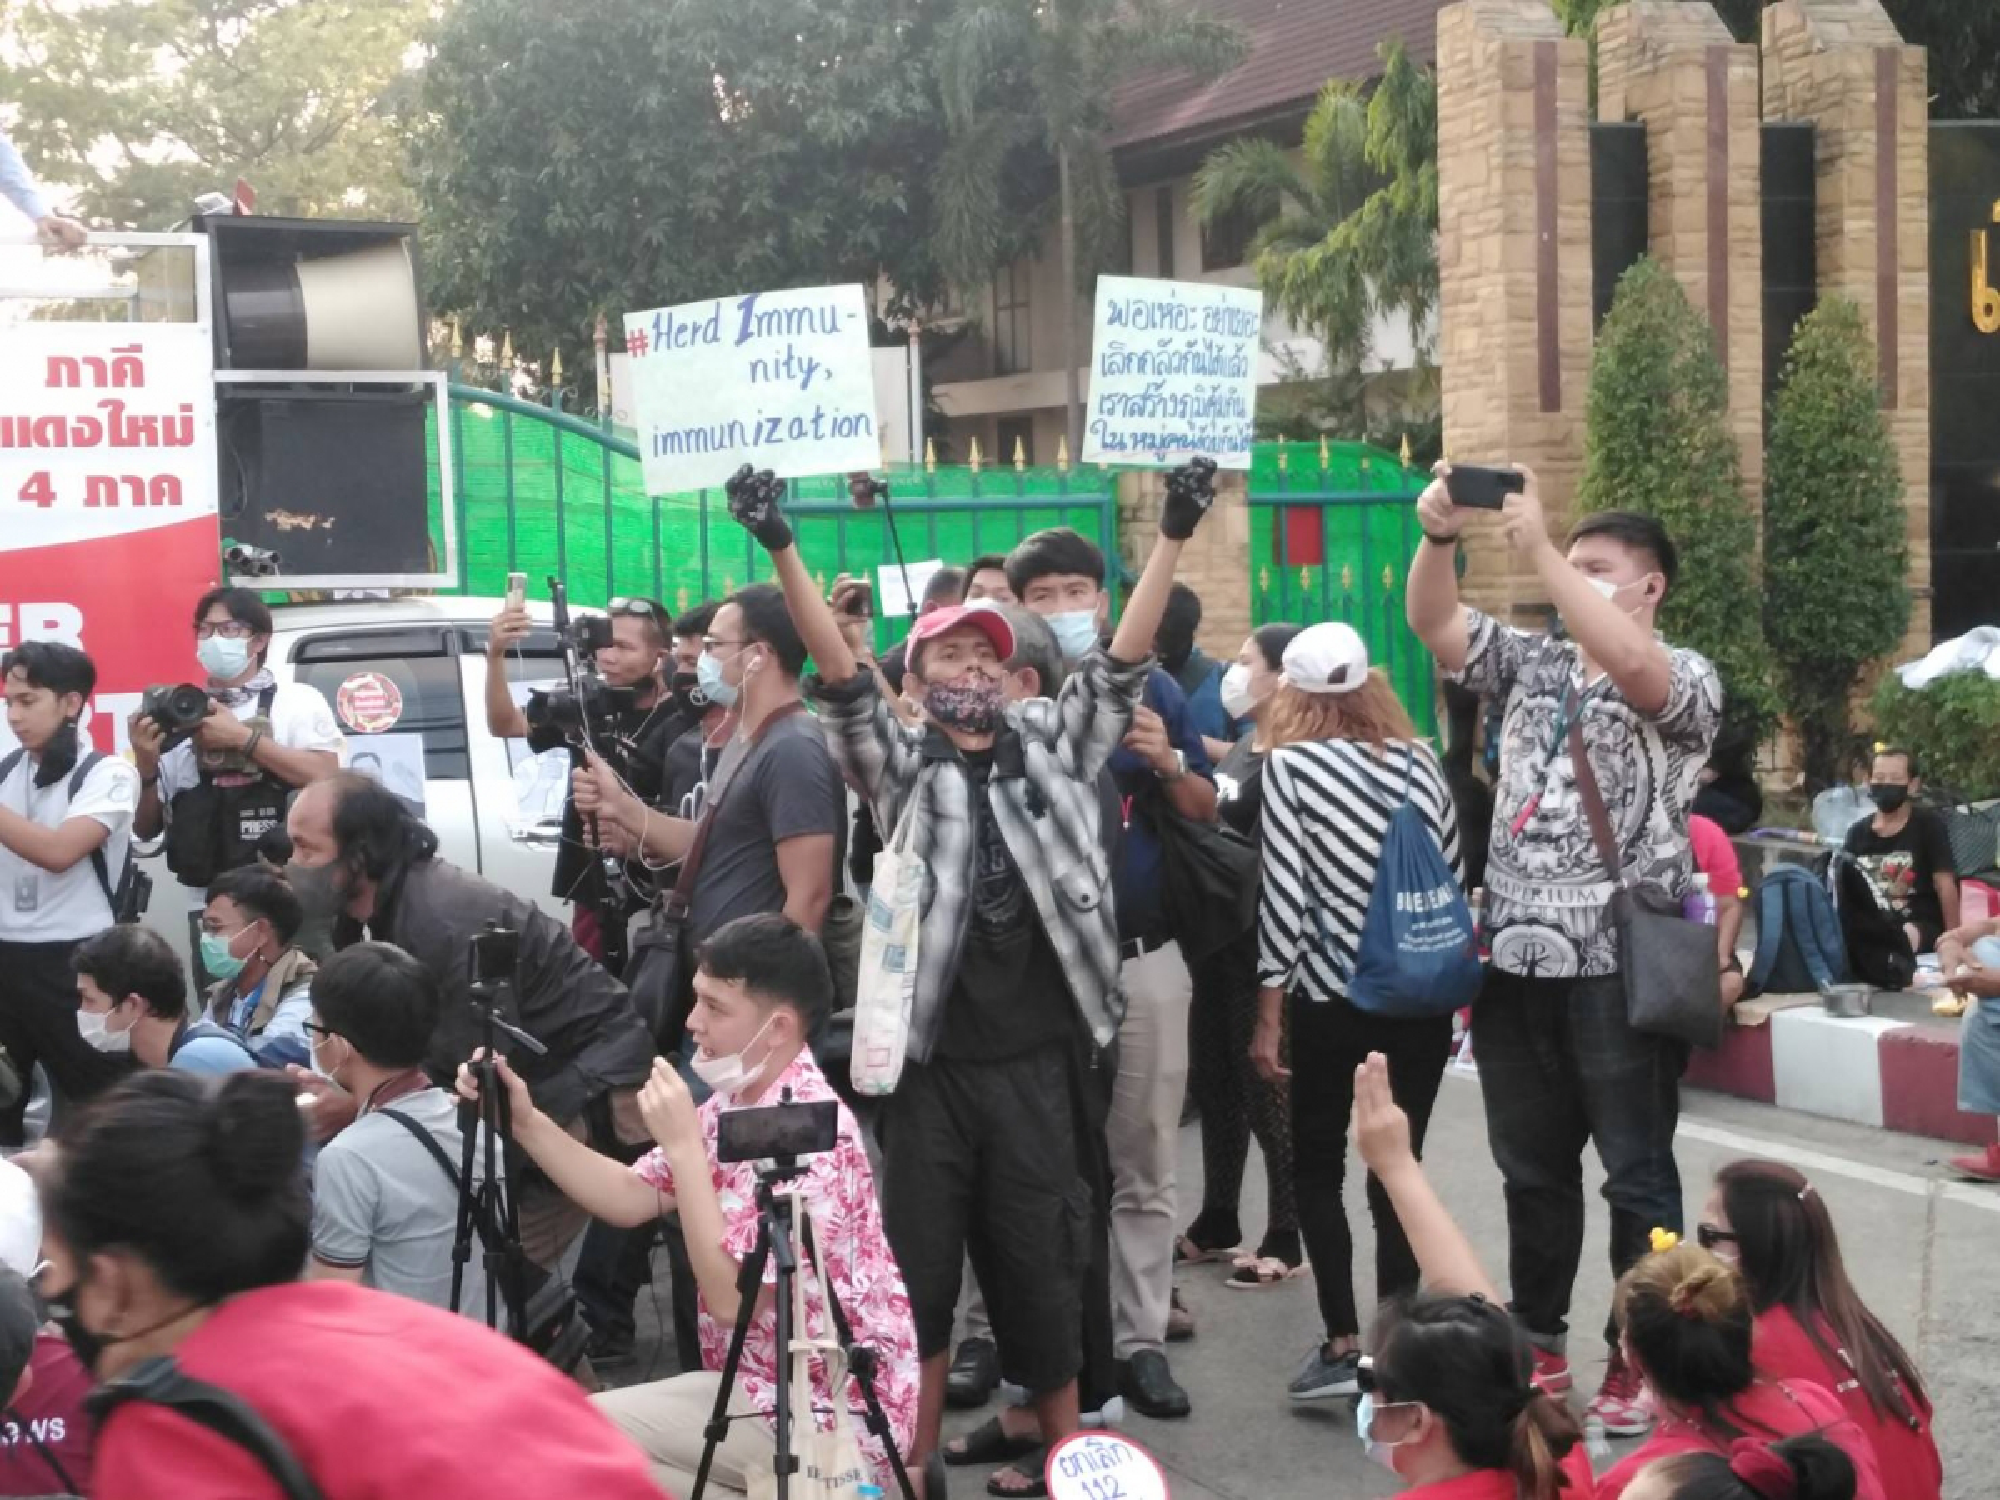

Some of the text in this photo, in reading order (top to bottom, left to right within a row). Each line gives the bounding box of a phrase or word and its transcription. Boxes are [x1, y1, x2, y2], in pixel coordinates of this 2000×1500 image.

[626, 301, 721, 358] #Herd
[45, 343, 145, 388] ภาคี
[749, 343, 833, 390] nity,
[651, 404, 872, 458] immunization
[18, 470, 183, 508] 4 ภาค
